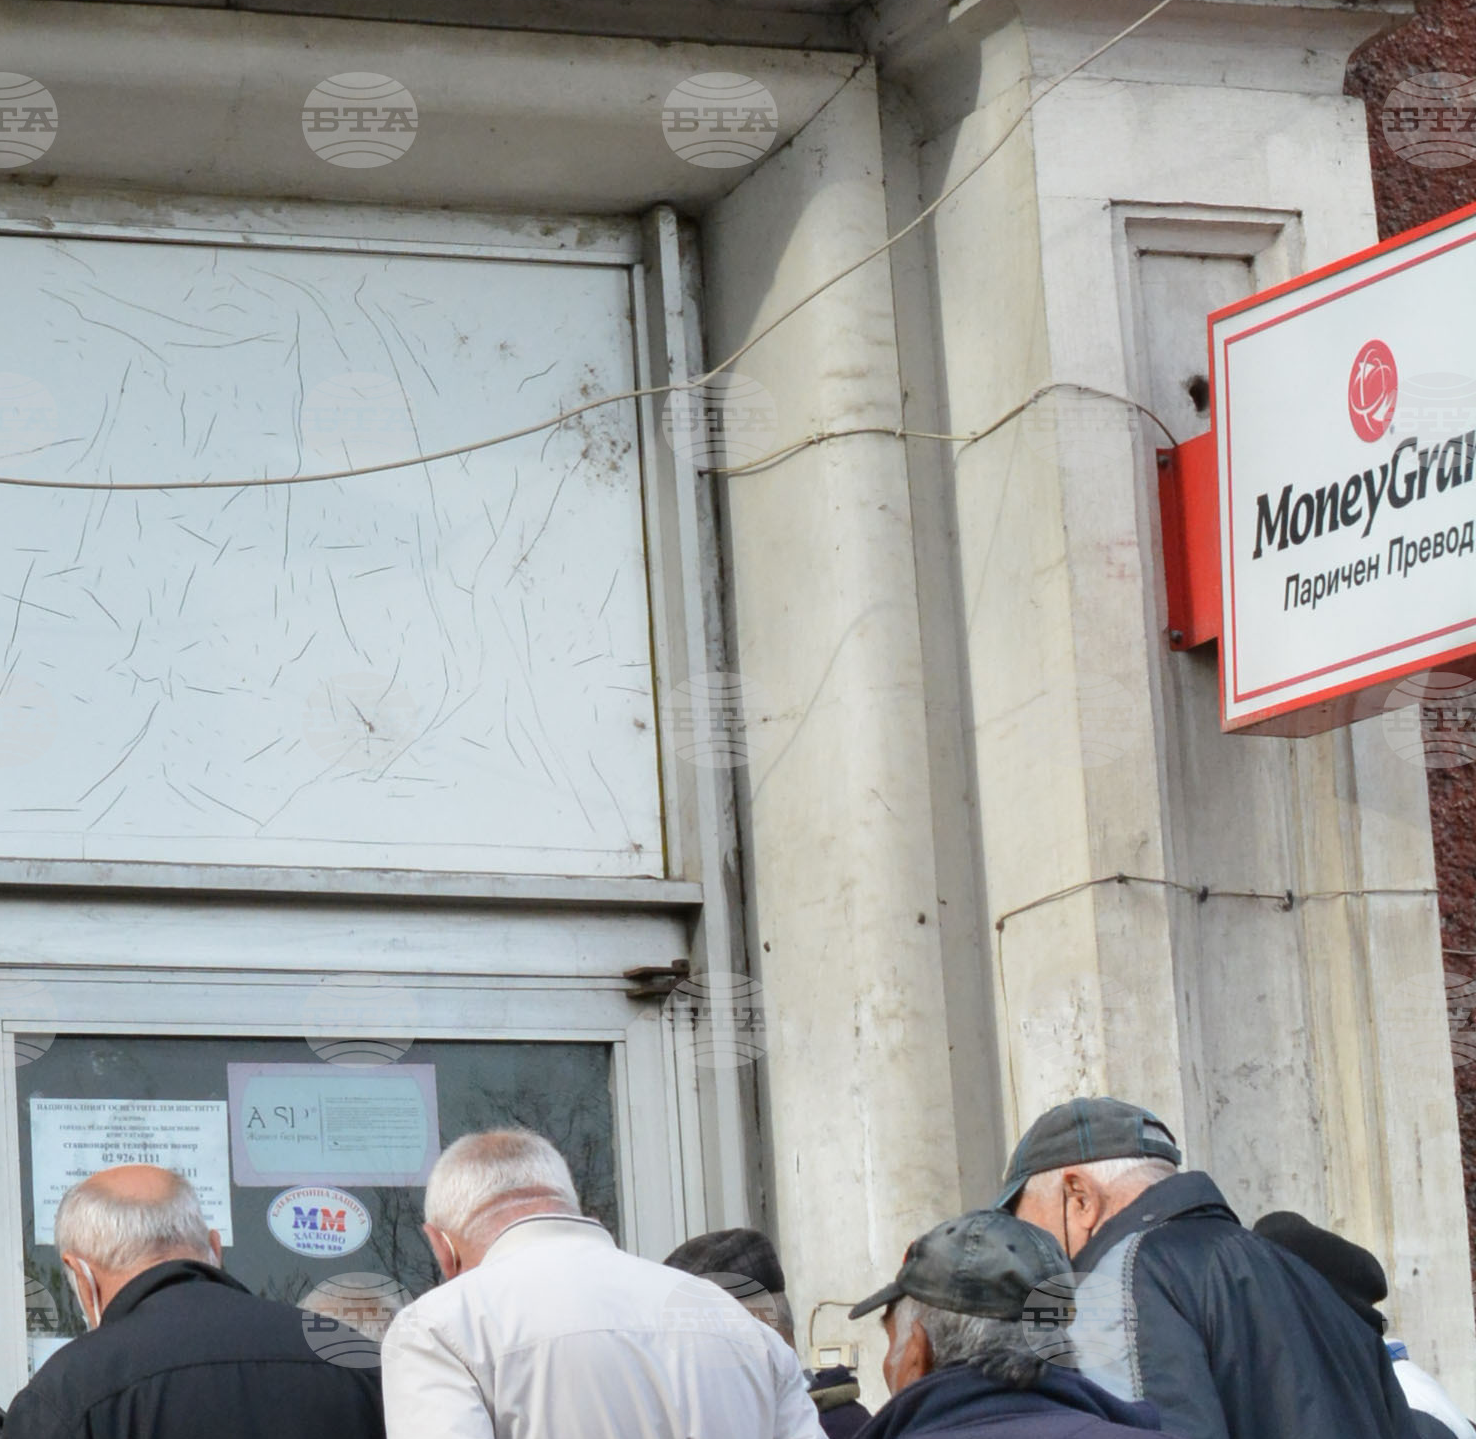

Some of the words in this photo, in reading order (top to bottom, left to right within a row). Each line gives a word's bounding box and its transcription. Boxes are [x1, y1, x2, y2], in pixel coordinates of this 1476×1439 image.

[1284, 553, 1380, 612] Паричен
[1387, 520, 1475, 578] Превод
[101, 1152, 114, 1163] 02
[116, 1152, 135, 1163] 926
[137, 1153, 160, 1163] 1111
[293, 1232, 346, 1245] ХАСКОВО
